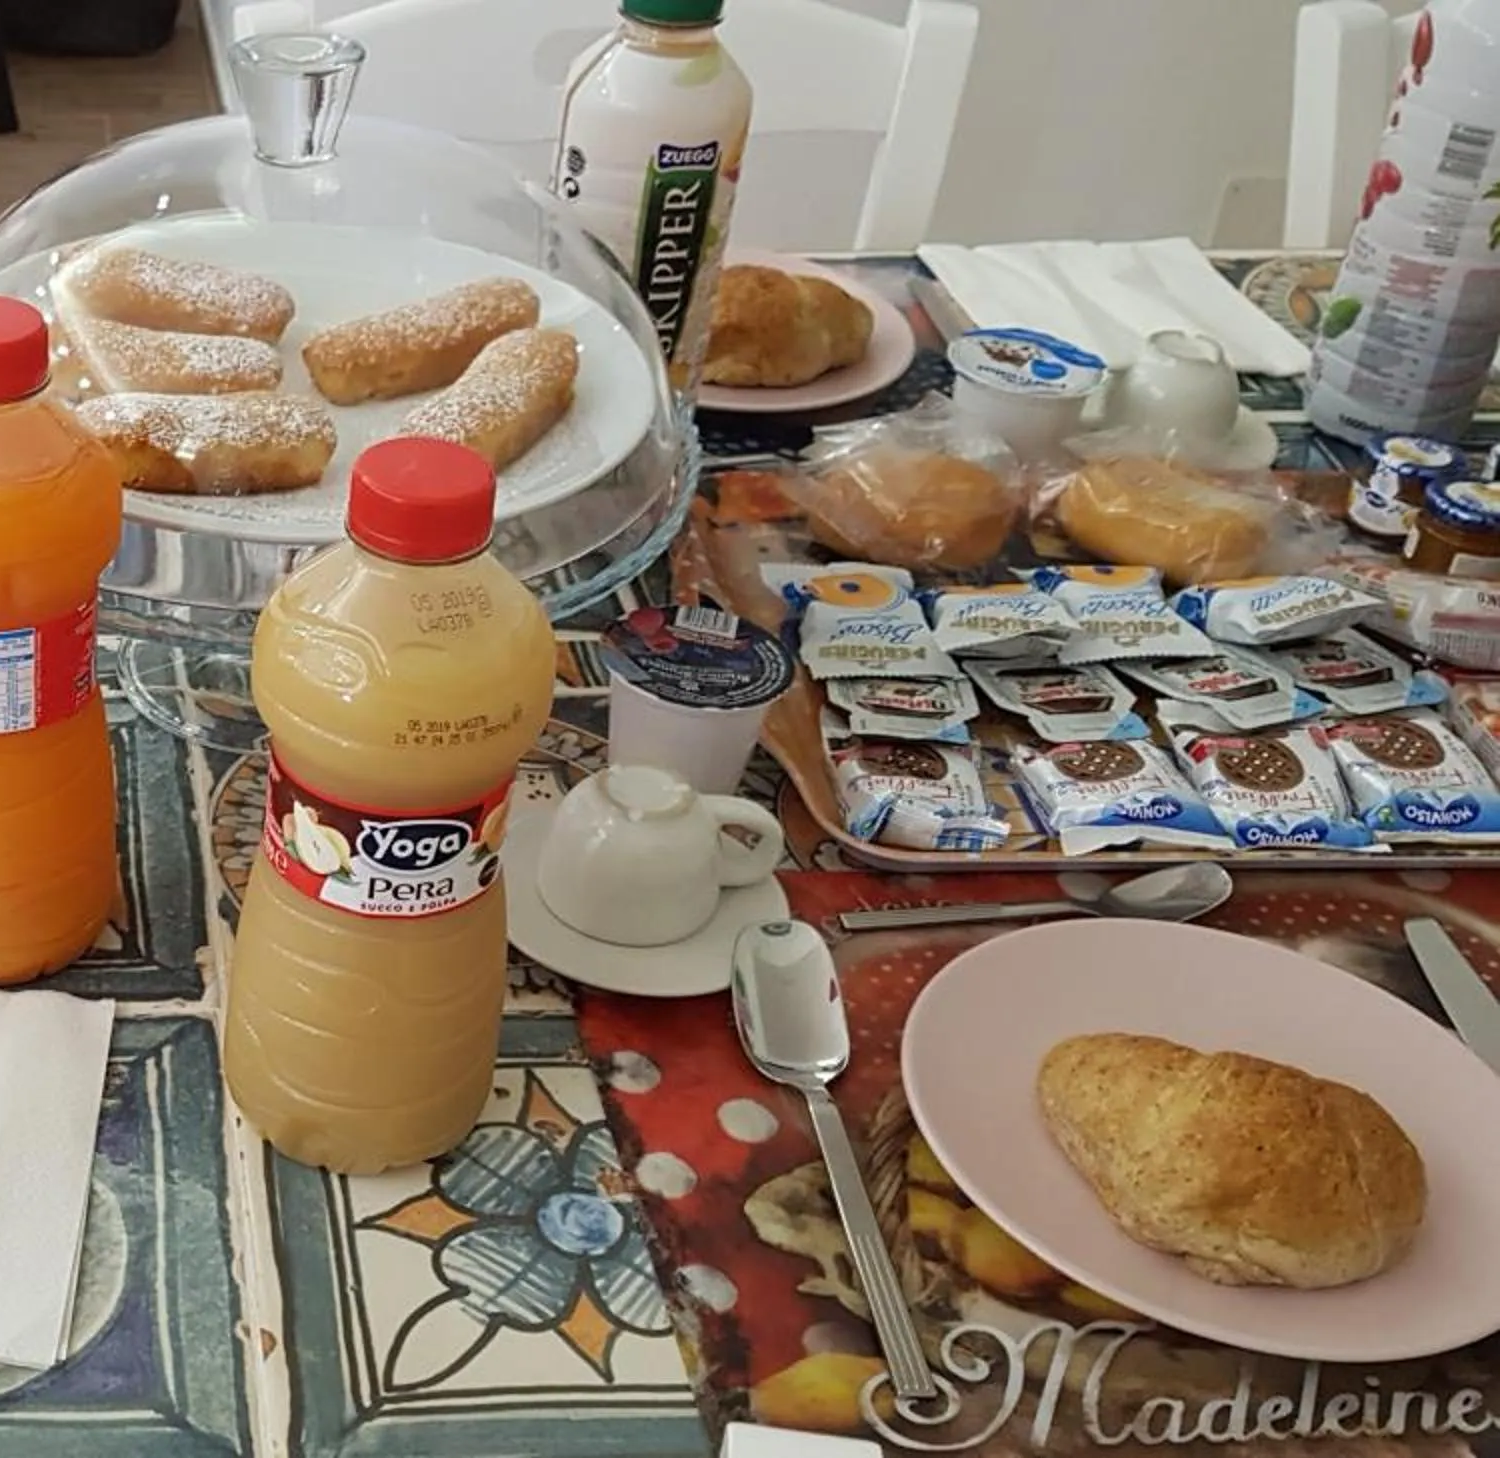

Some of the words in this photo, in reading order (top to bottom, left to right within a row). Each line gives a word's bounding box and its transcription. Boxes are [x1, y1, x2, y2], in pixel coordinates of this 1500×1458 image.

[660, 148, 715, 163] ZUEGG
[1114, 802, 1179, 820] MONVI
[1405, 805, 1474, 827] MONVISO
[372, 827, 461, 867] Yoga
[360, 902, 402, 913] SUCCO
[421, 896, 457, 910] POLPA
[859, 1320, 1500, 1450] Madeleine
